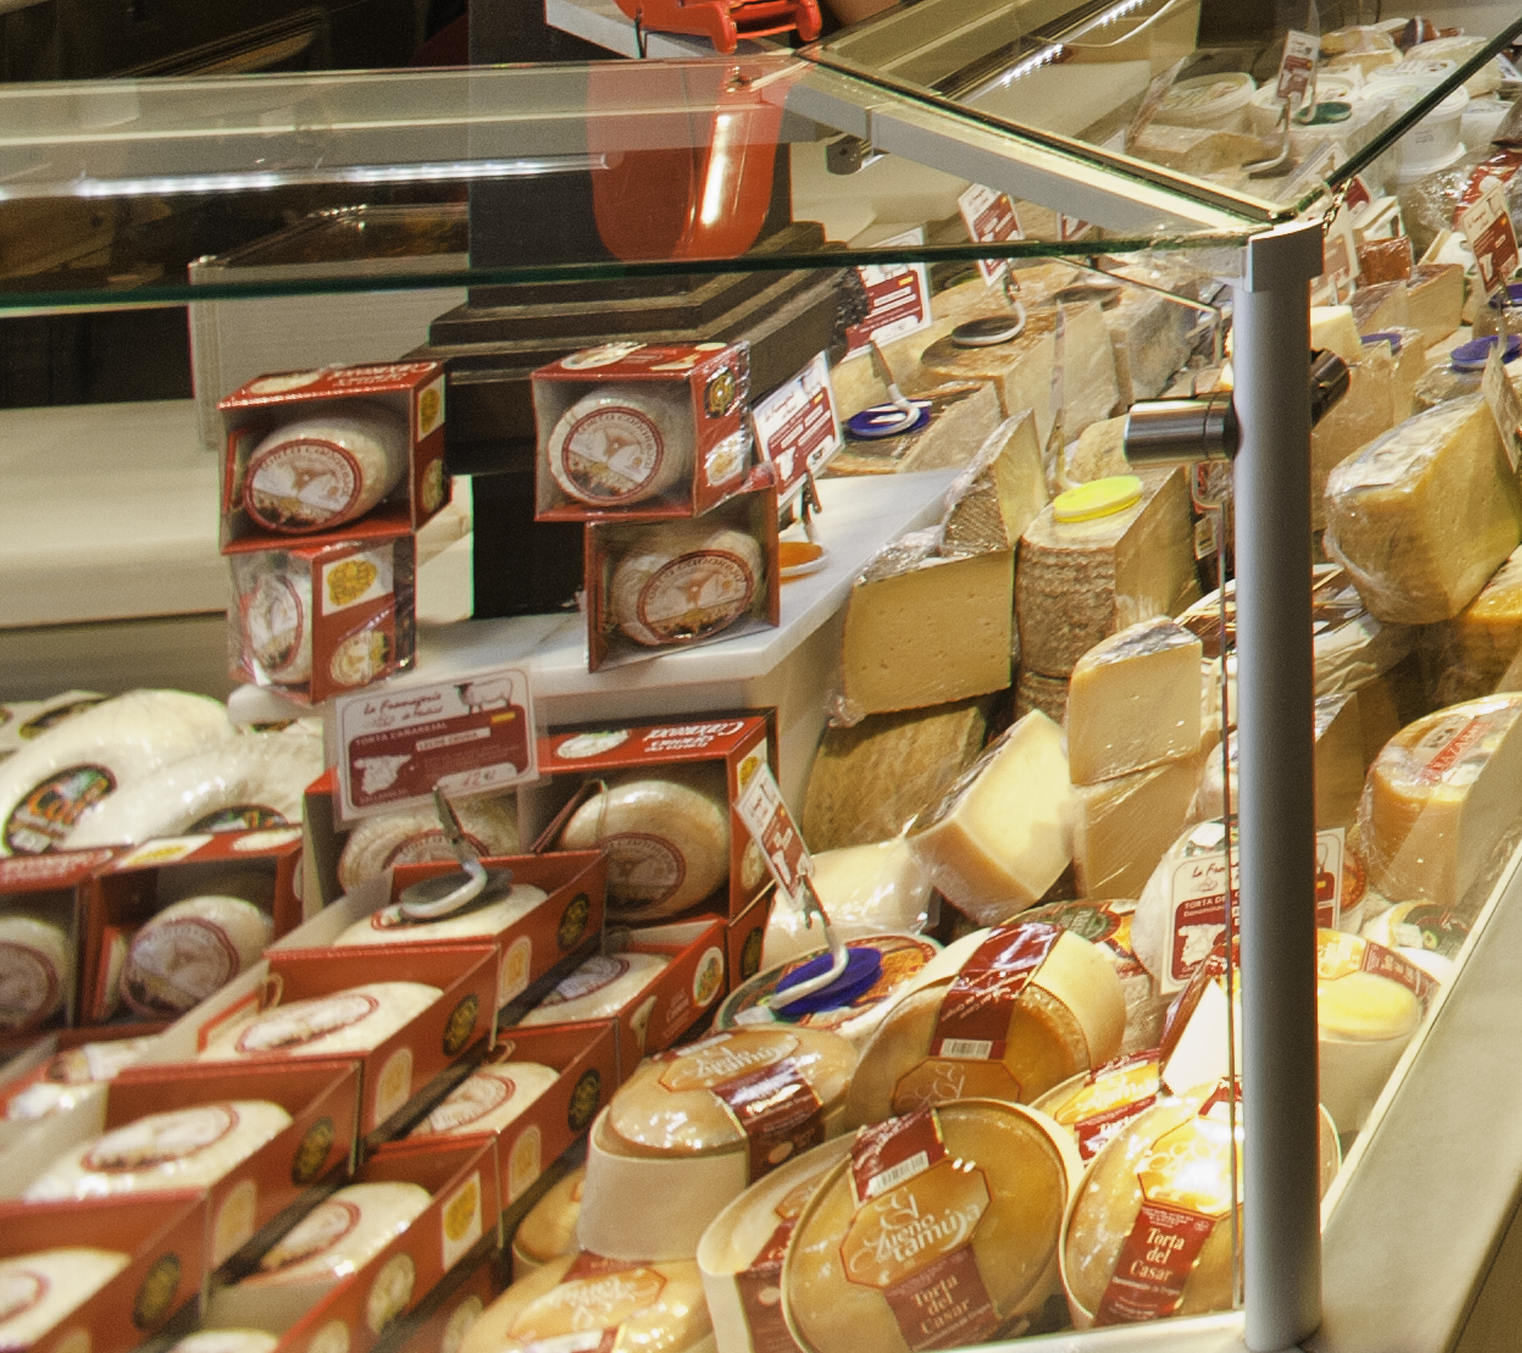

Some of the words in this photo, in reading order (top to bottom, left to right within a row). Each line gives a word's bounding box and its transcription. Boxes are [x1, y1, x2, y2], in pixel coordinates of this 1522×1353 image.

[1146, 1227, 1186, 1251] Torta
[1146, 1247, 1172, 1265] del
[1130, 1259, 1174, 1282] Casar
